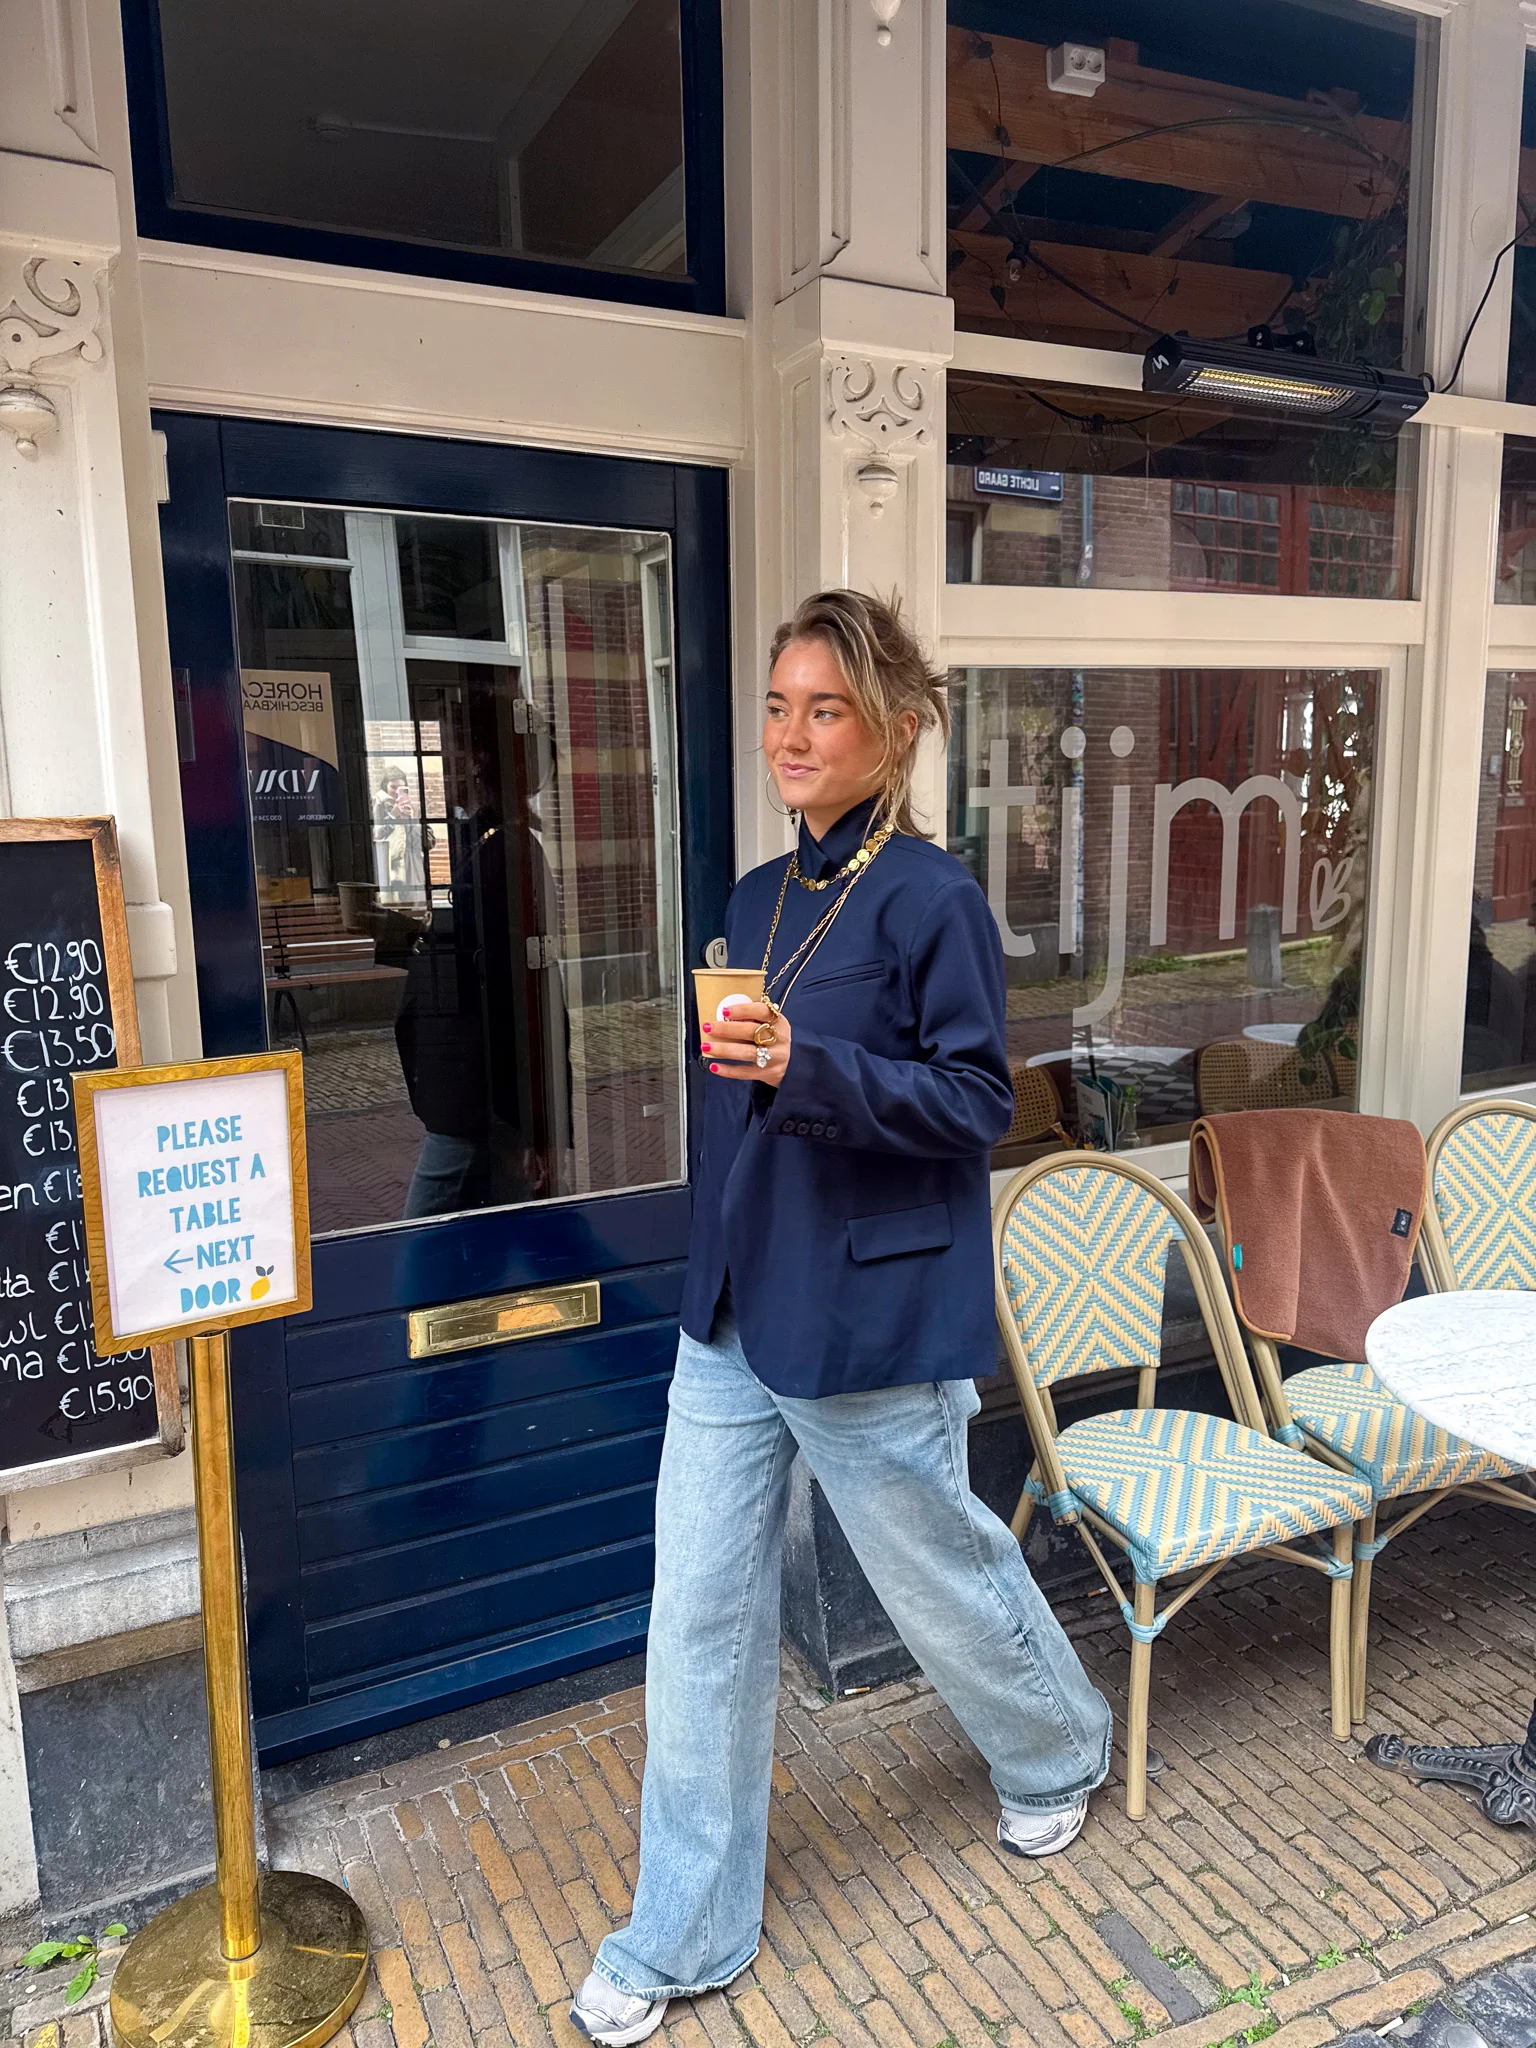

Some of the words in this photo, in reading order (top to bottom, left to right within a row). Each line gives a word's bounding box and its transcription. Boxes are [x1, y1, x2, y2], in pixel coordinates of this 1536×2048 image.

[969, 725, 1301, 1028] tijm
[157, 1115, 242, 1152] PLEASE
[138, 1157, 240, 1198] REQUEST
[250, 1153, 266, 1179] A
[169, 1197, 241, 1233] TABLE
[197, 1235, 255, 1270] NEXT
[180, 1278, 241, 1313] DOOR
